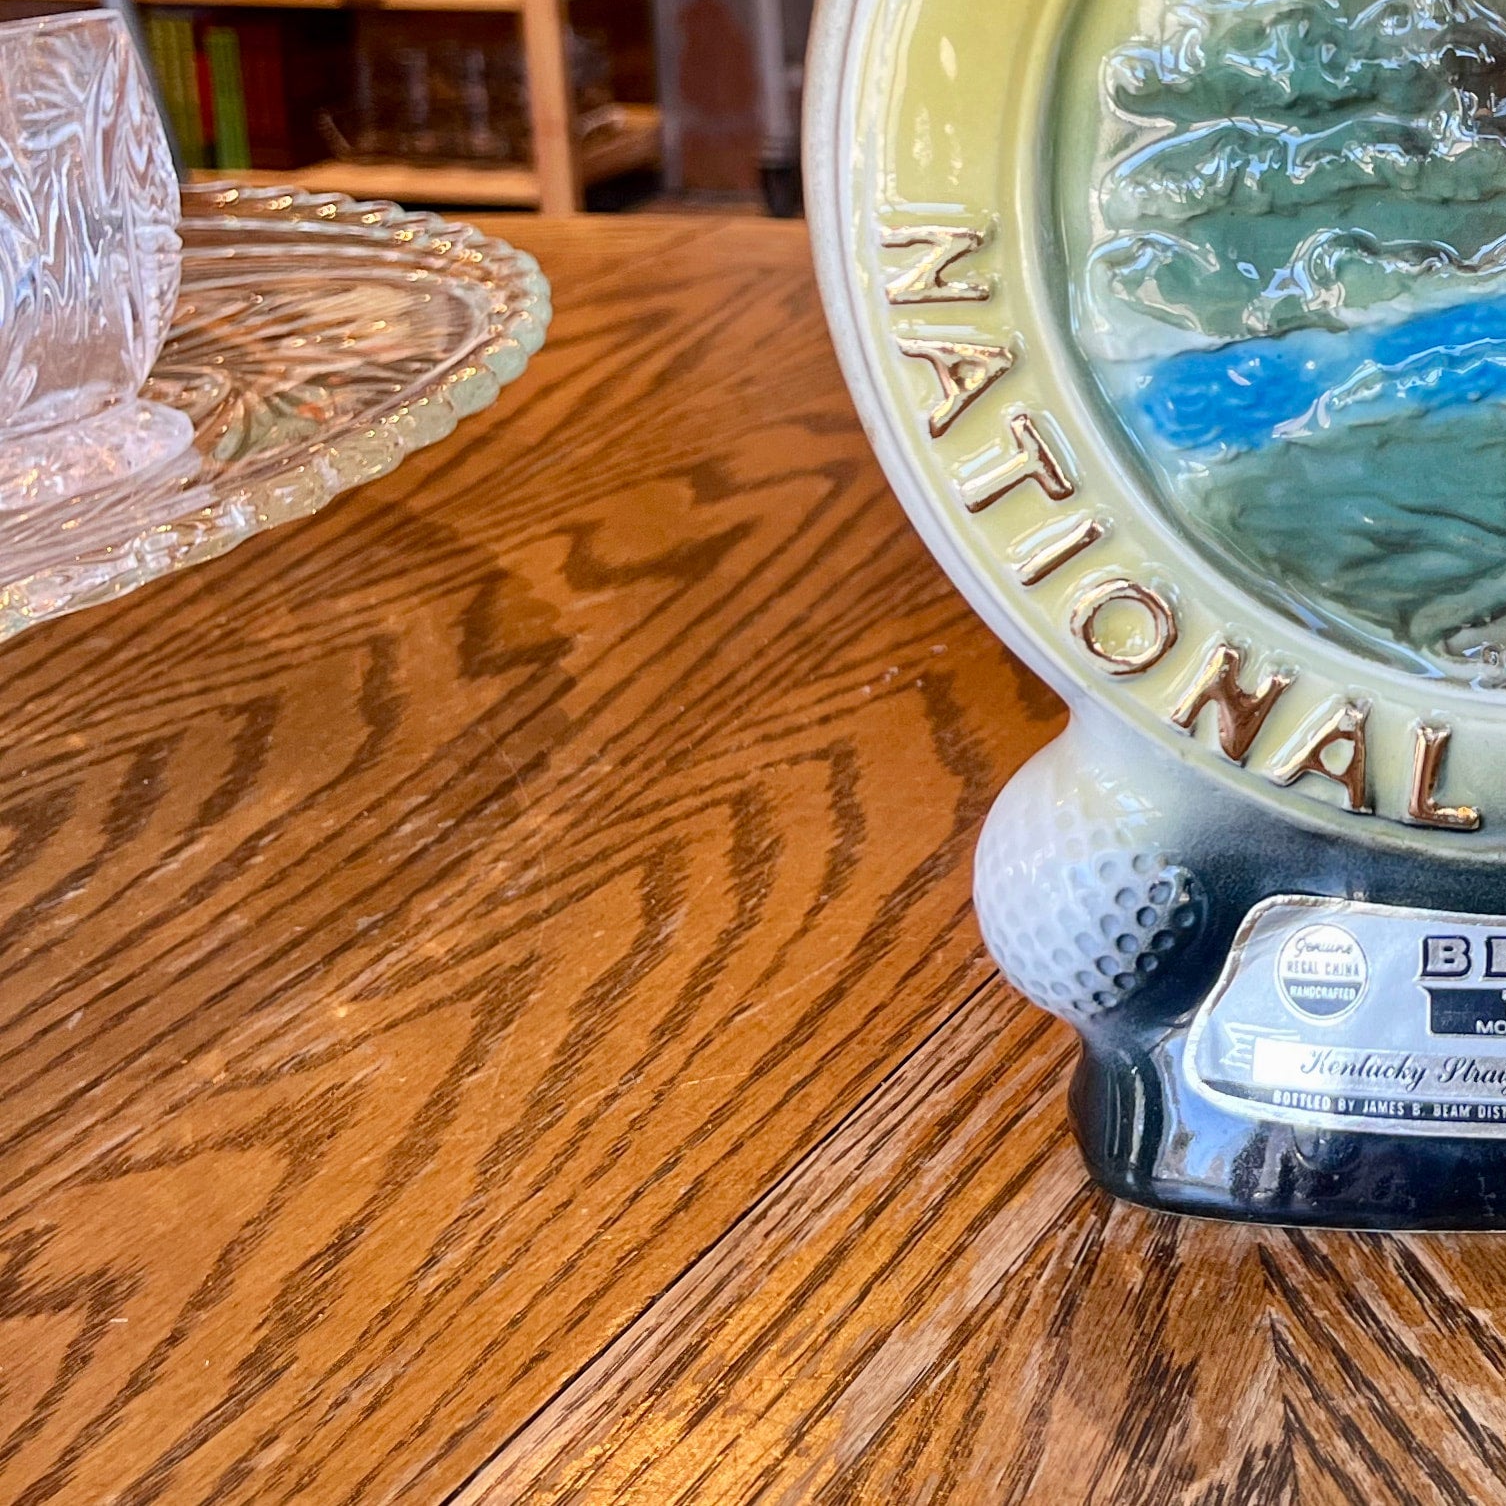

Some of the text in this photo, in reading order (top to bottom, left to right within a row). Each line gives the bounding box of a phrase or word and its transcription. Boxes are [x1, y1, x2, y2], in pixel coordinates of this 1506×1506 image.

[880, 225, 1483, 830] NATIONAL
[1300, 1049, 1426, 1092] Kentucky
[1272, 1089, 1332, 1112] BOTTLED
[1337, 1097, 1354, 1113] BY
[1361, 1099, 1405, 1116] JAMES
[1432, 1104, 1472, 1119] BEAM
